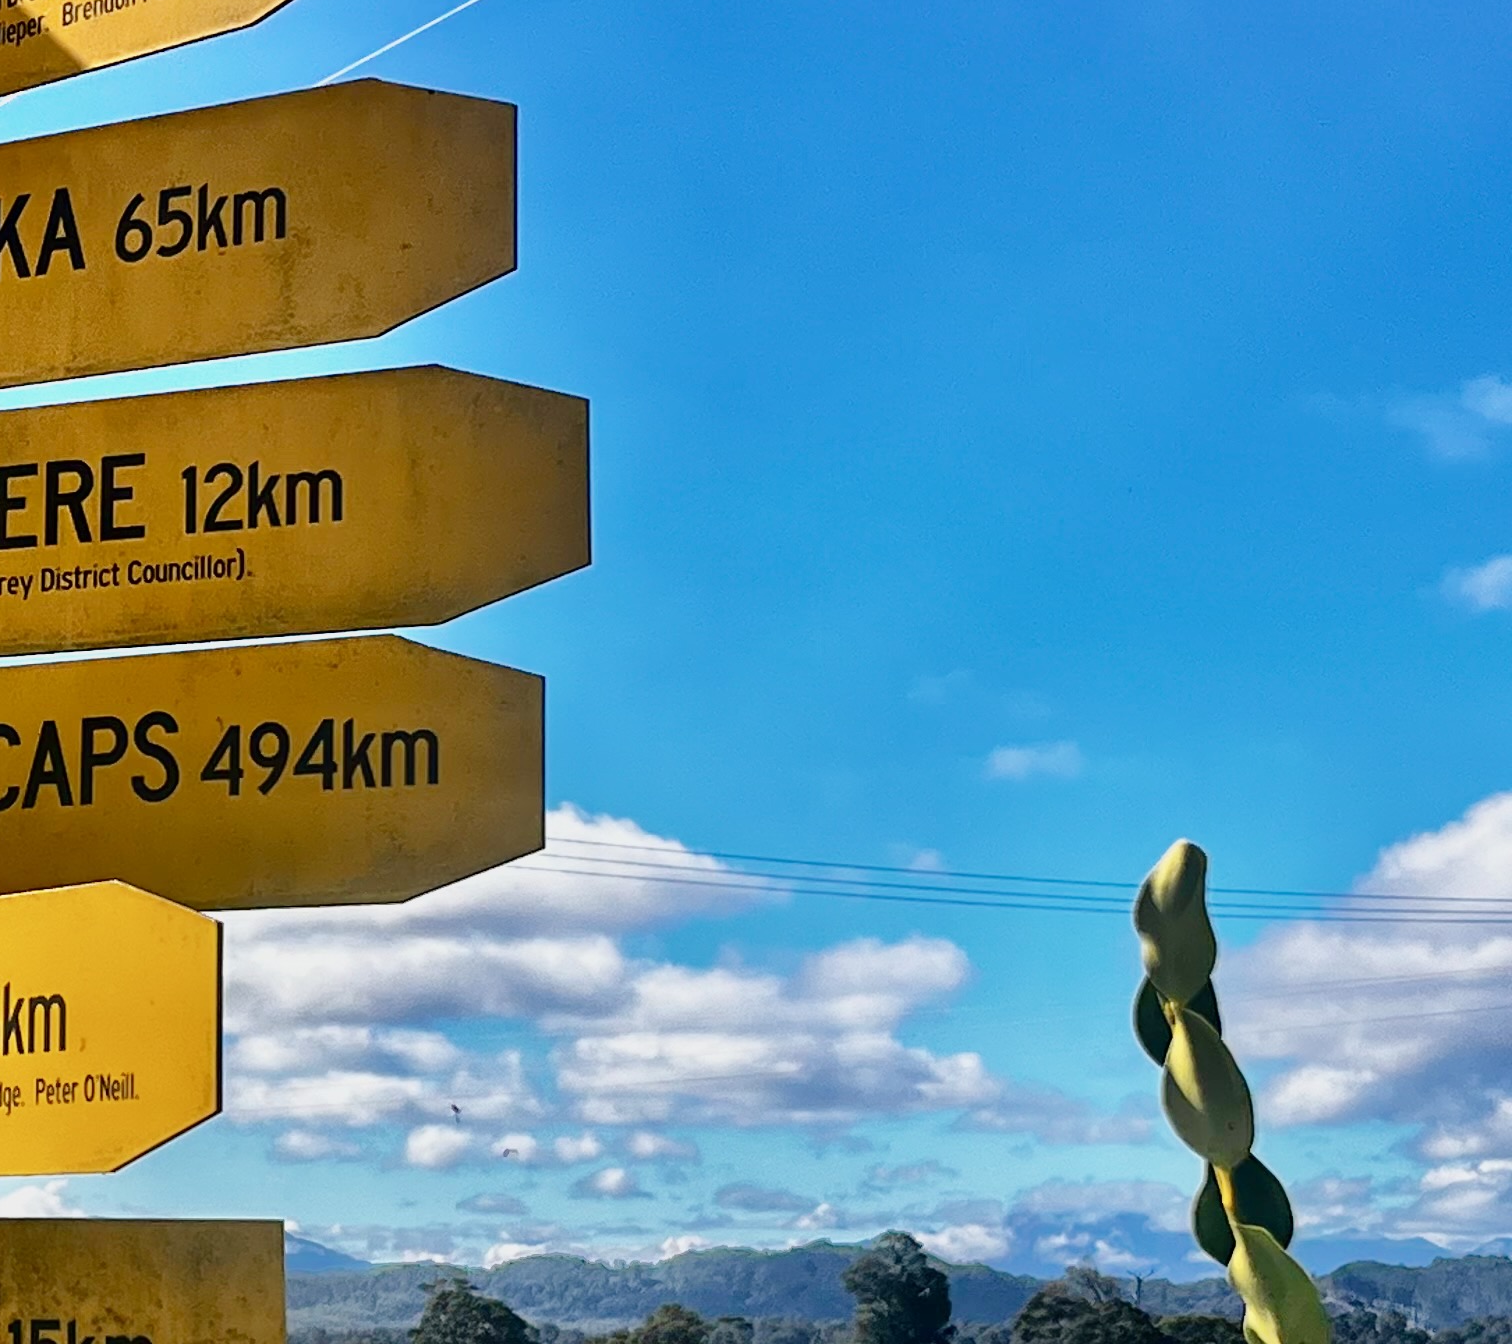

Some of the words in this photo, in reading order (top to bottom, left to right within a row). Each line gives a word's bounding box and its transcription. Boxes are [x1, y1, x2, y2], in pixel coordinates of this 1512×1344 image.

[115, 182, 288, 263] 65km
[181, 460, 343, 535] 12km
[41, 561, 120, 594] District
[127, 548, 254, 585] Councillor).
[201, 717, 440, 797] 494km
[35, 1077, 79, 1106] Peter
